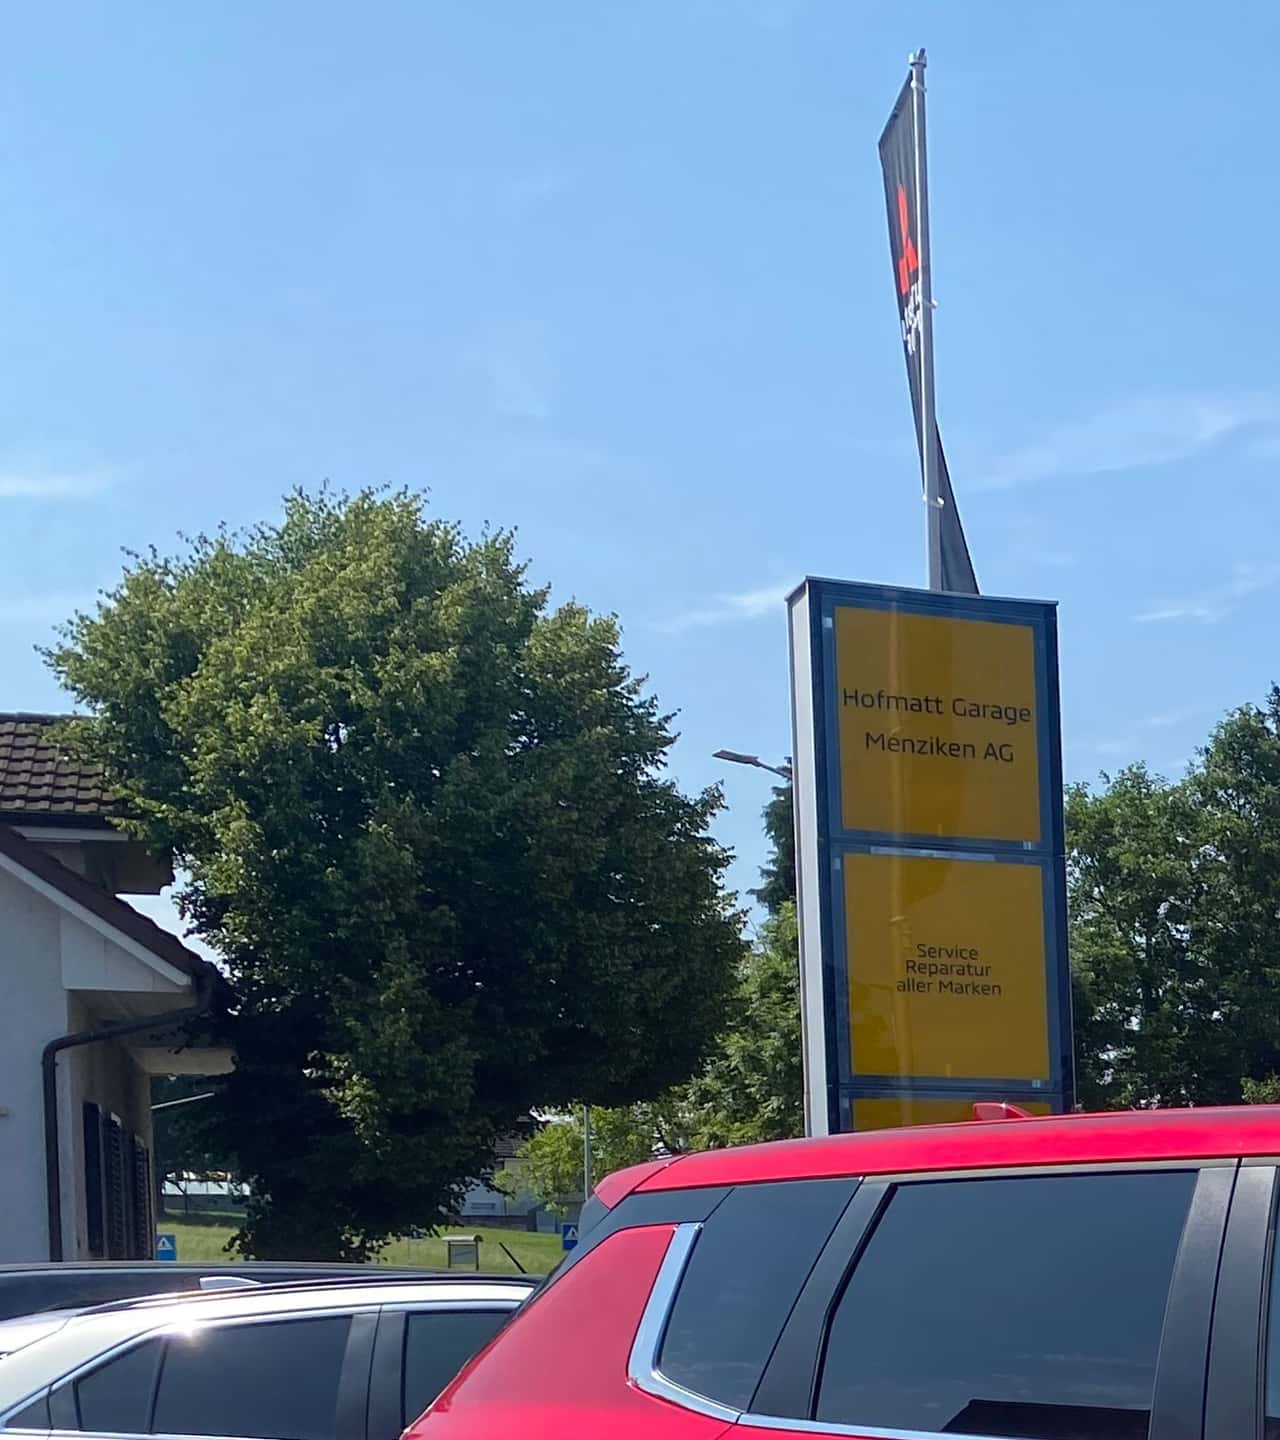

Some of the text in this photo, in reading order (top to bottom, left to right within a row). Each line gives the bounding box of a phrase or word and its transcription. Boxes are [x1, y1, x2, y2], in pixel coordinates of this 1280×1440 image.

[843, 688, 1031, 725] Hofmatt Garage
[865, 731, 1014, 762] Menziken AG
[916, 943, 978, 960] Service
[905, 960, 992, 977] Reparatur
[896, 978, 1002, 996] aller Marken
